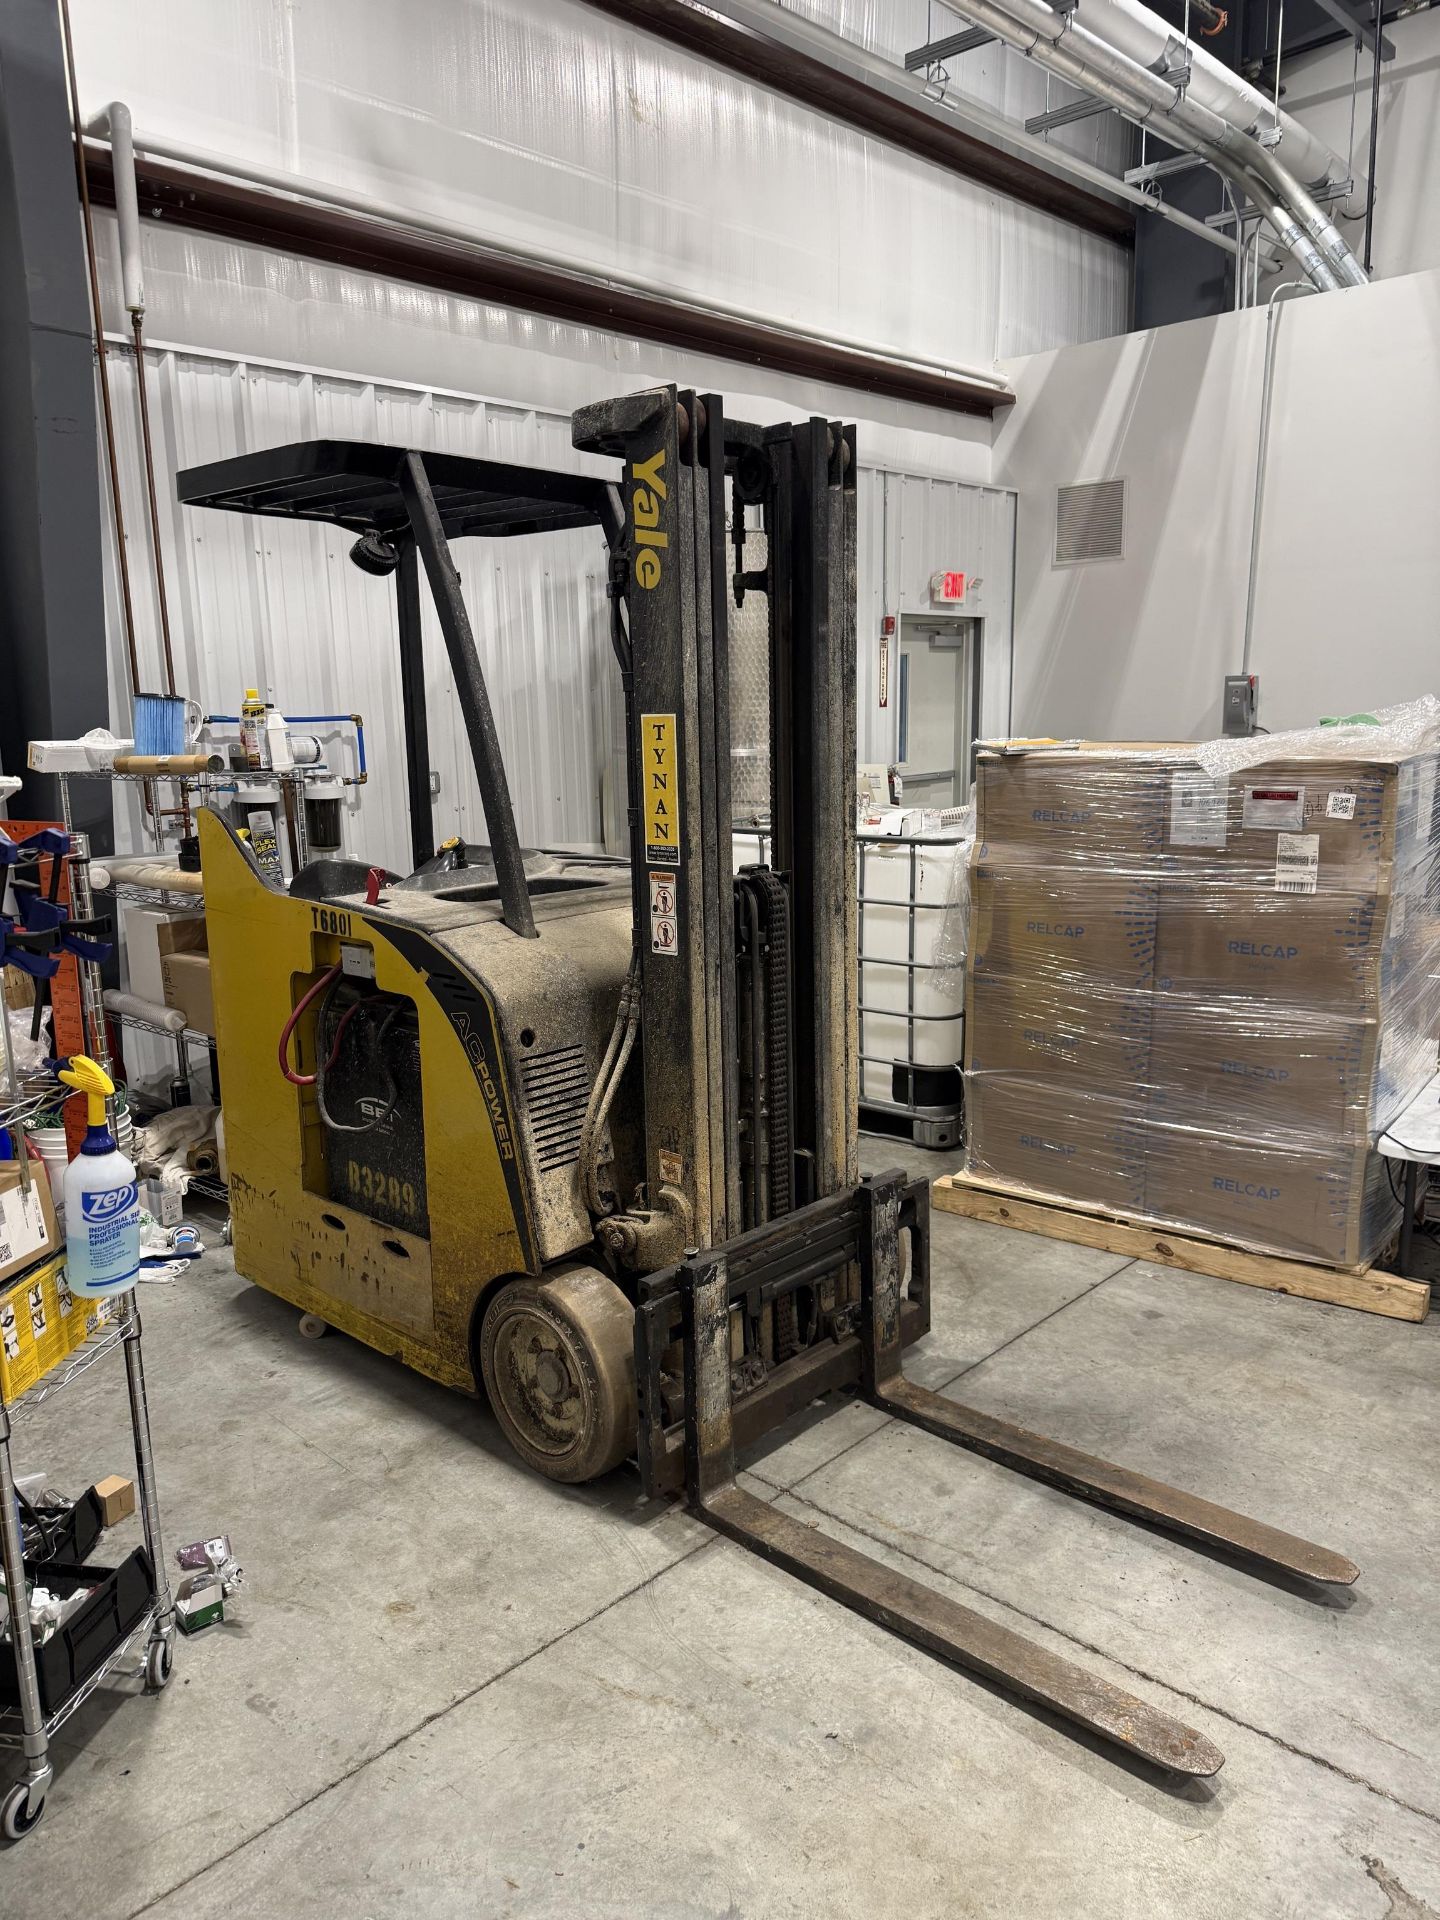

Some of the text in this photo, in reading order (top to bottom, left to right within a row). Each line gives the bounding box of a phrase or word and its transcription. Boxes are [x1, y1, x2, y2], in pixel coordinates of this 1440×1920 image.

[632, 449, 668, 590] Yale
[652, 724, 670, 840] TYNAN
[1031, 809, 1091, 823] RELCAP
[254, 838, 276, 849] FLEX
[256, 844, 278, 856] SEAL
[258, 855, 280, 865] MAX
[1026, 921, 1085, 938] RELCAP
[1228, 940, 1298, 960] RELCAP
[1213, 1177, 1281, 1201] RELCAP
[88, 1216, 129, 1234] INDUSTRIAL
[88, 1219, 139, 1240] PROFESSIONAL
[89, 1232, 121, 1247] SPRAYER
